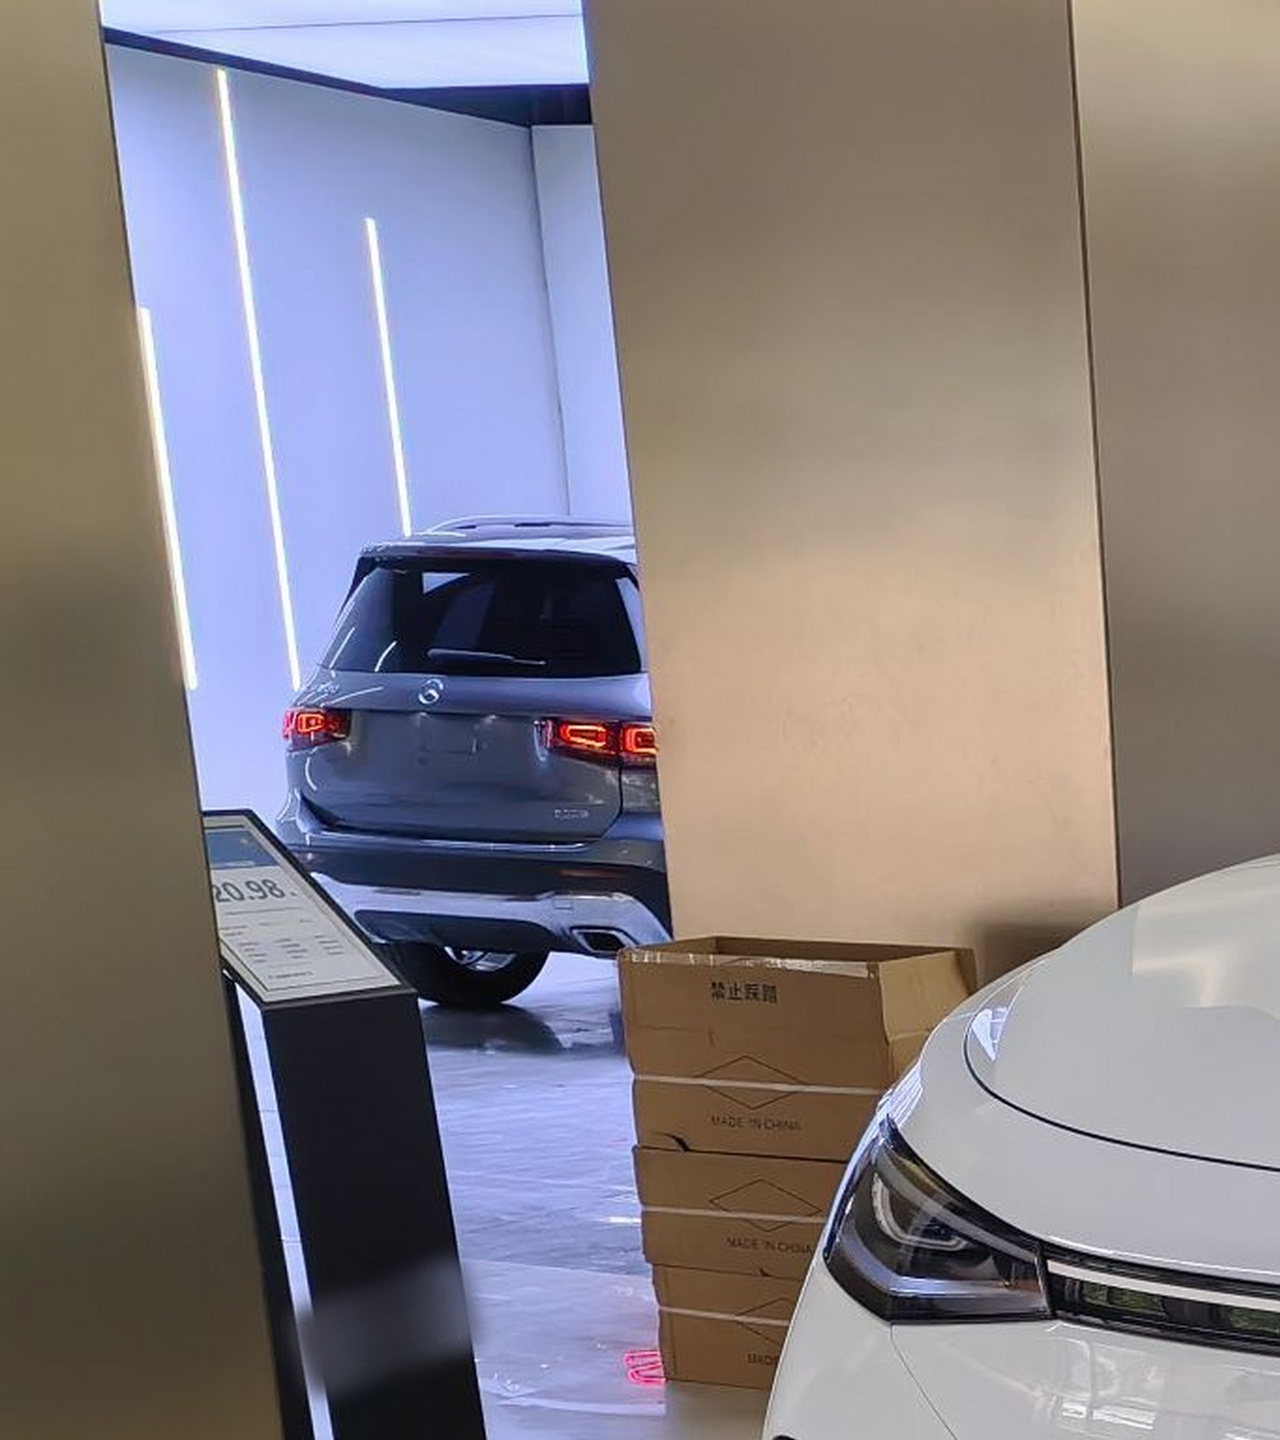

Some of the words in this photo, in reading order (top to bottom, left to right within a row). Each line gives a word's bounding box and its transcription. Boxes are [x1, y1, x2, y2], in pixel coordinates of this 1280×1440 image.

[210, 879, 285, 902] 20.98
[711, 1116, 745, 1127] MADE
[763, 1119, 802, 1130] CHINA
